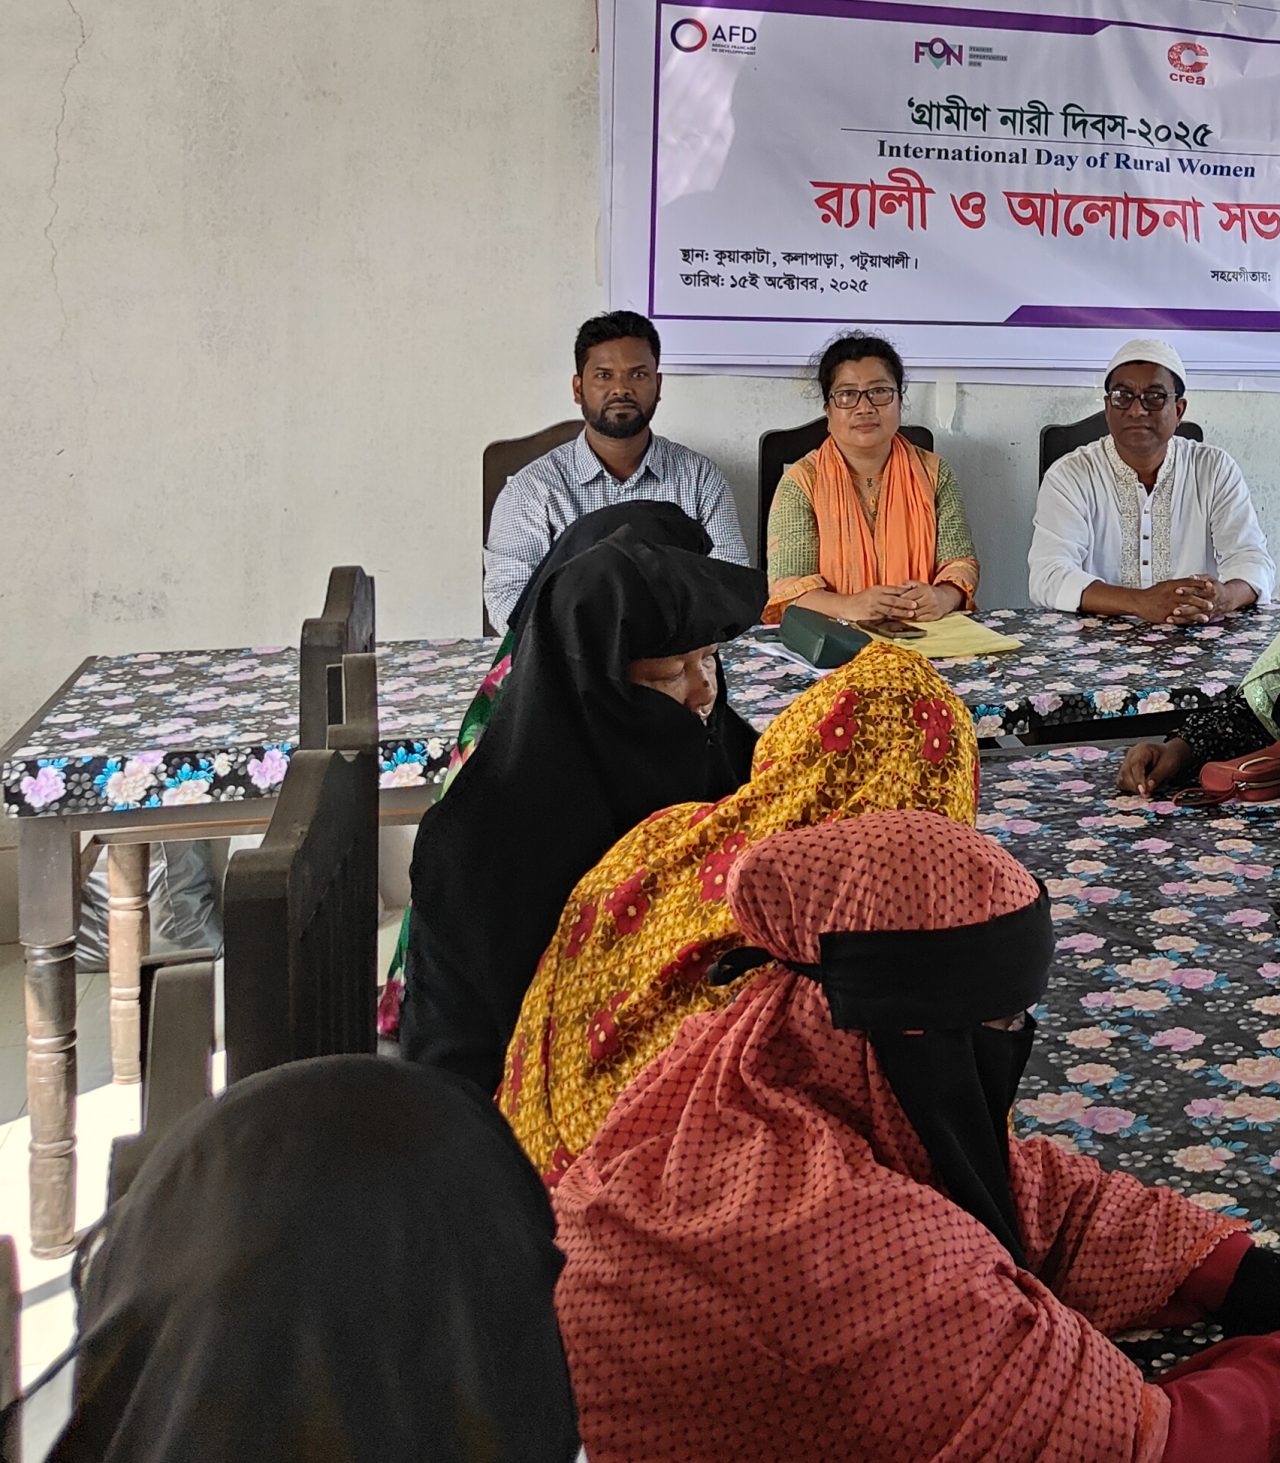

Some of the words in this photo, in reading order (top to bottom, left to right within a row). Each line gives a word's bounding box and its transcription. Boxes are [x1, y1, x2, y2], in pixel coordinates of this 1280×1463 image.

[712, 24, 757, 43] AFD
[1169, 72, 1206, 86] crea
[996, 99, 1055, 137] নারী
[1059, 102, 1214, 150] দিবস-২০২৫
[877, 139, 1028, 165] International
[1035, 148, 1079, 171] Day
[1086, 152, 1110, 168] of
[1115, 152, 1171, 173] Rural
[1177, 157, 1256, 178] Women
[950, 190, 986, 230] ও
[1002, 188, 1205, 245] আলোচনা
[730, 271, 760, 290] ১৫ই
[829, 277, 869, 293] ২০২৫
